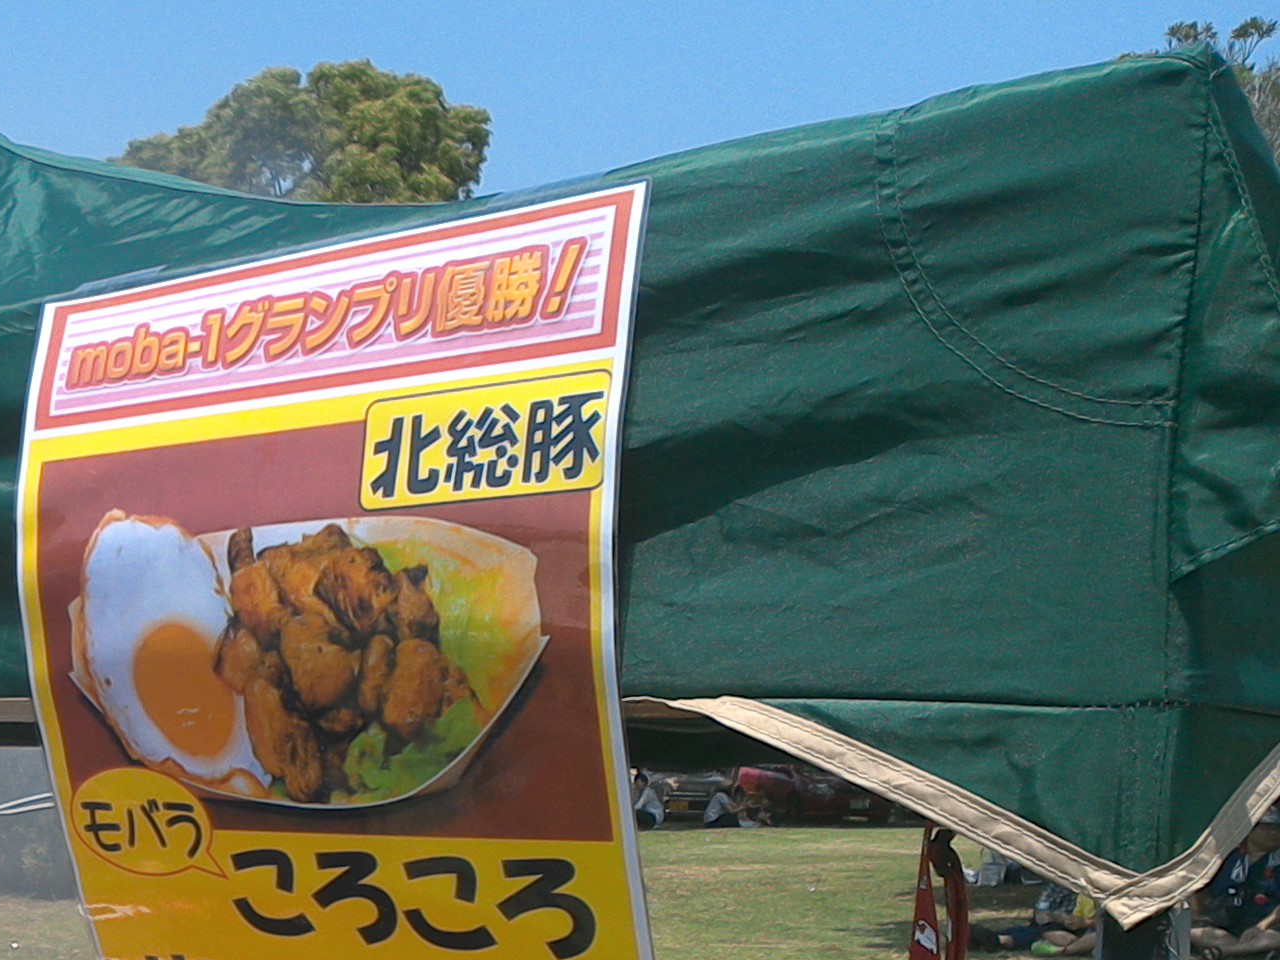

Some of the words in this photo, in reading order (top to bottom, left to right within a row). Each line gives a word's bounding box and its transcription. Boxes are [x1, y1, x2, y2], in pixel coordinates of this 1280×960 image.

[370, 390, 605, 498] 北総豚
[80, 801, 203, 858] モバラ
[230, 848, 596, 960] ころころ
